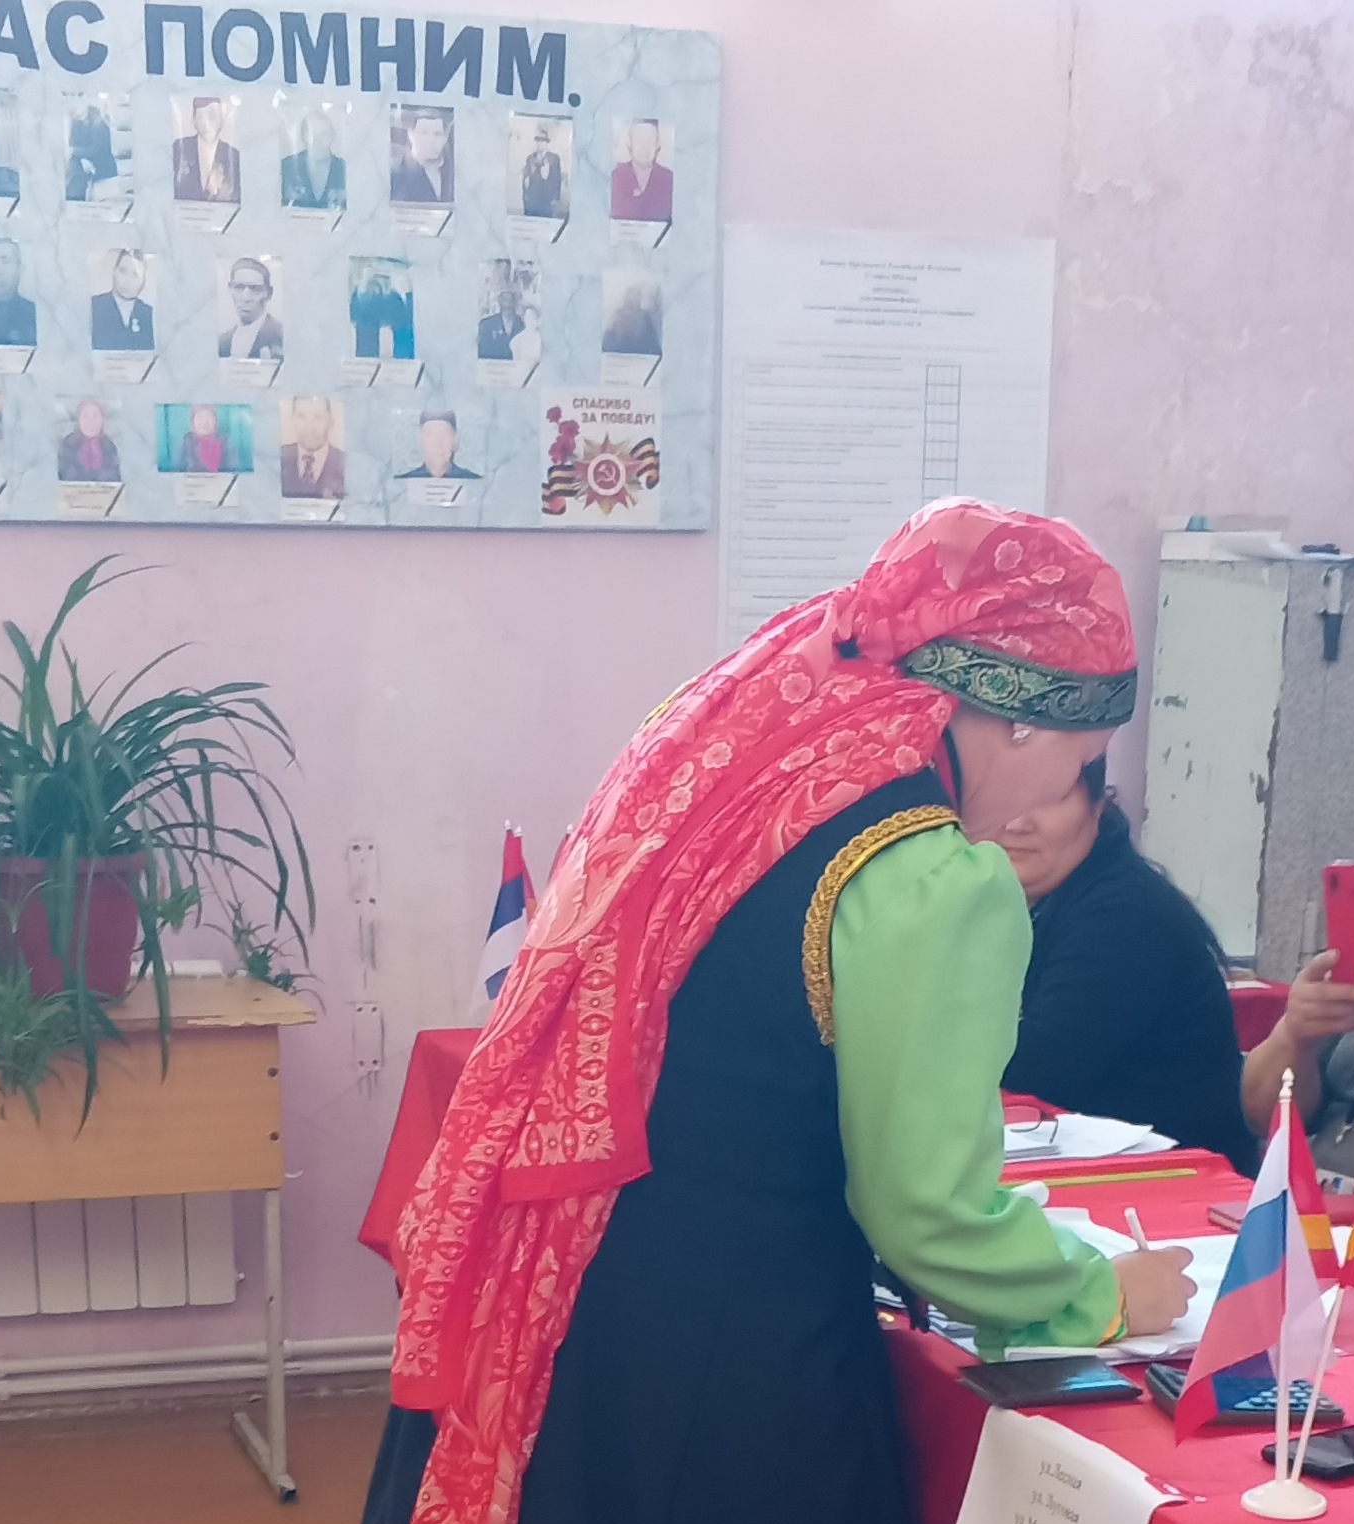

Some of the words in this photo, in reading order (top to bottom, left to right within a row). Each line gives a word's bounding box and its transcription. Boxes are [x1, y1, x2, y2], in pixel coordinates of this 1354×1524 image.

[144, 3, 582, 108] ПОМНИМ.
[572, 397, 632, 410] СПАСИБО
[581, 412, 598, 424] ЗА
[601, 412, 656, 426] ПОБЕДУ!
